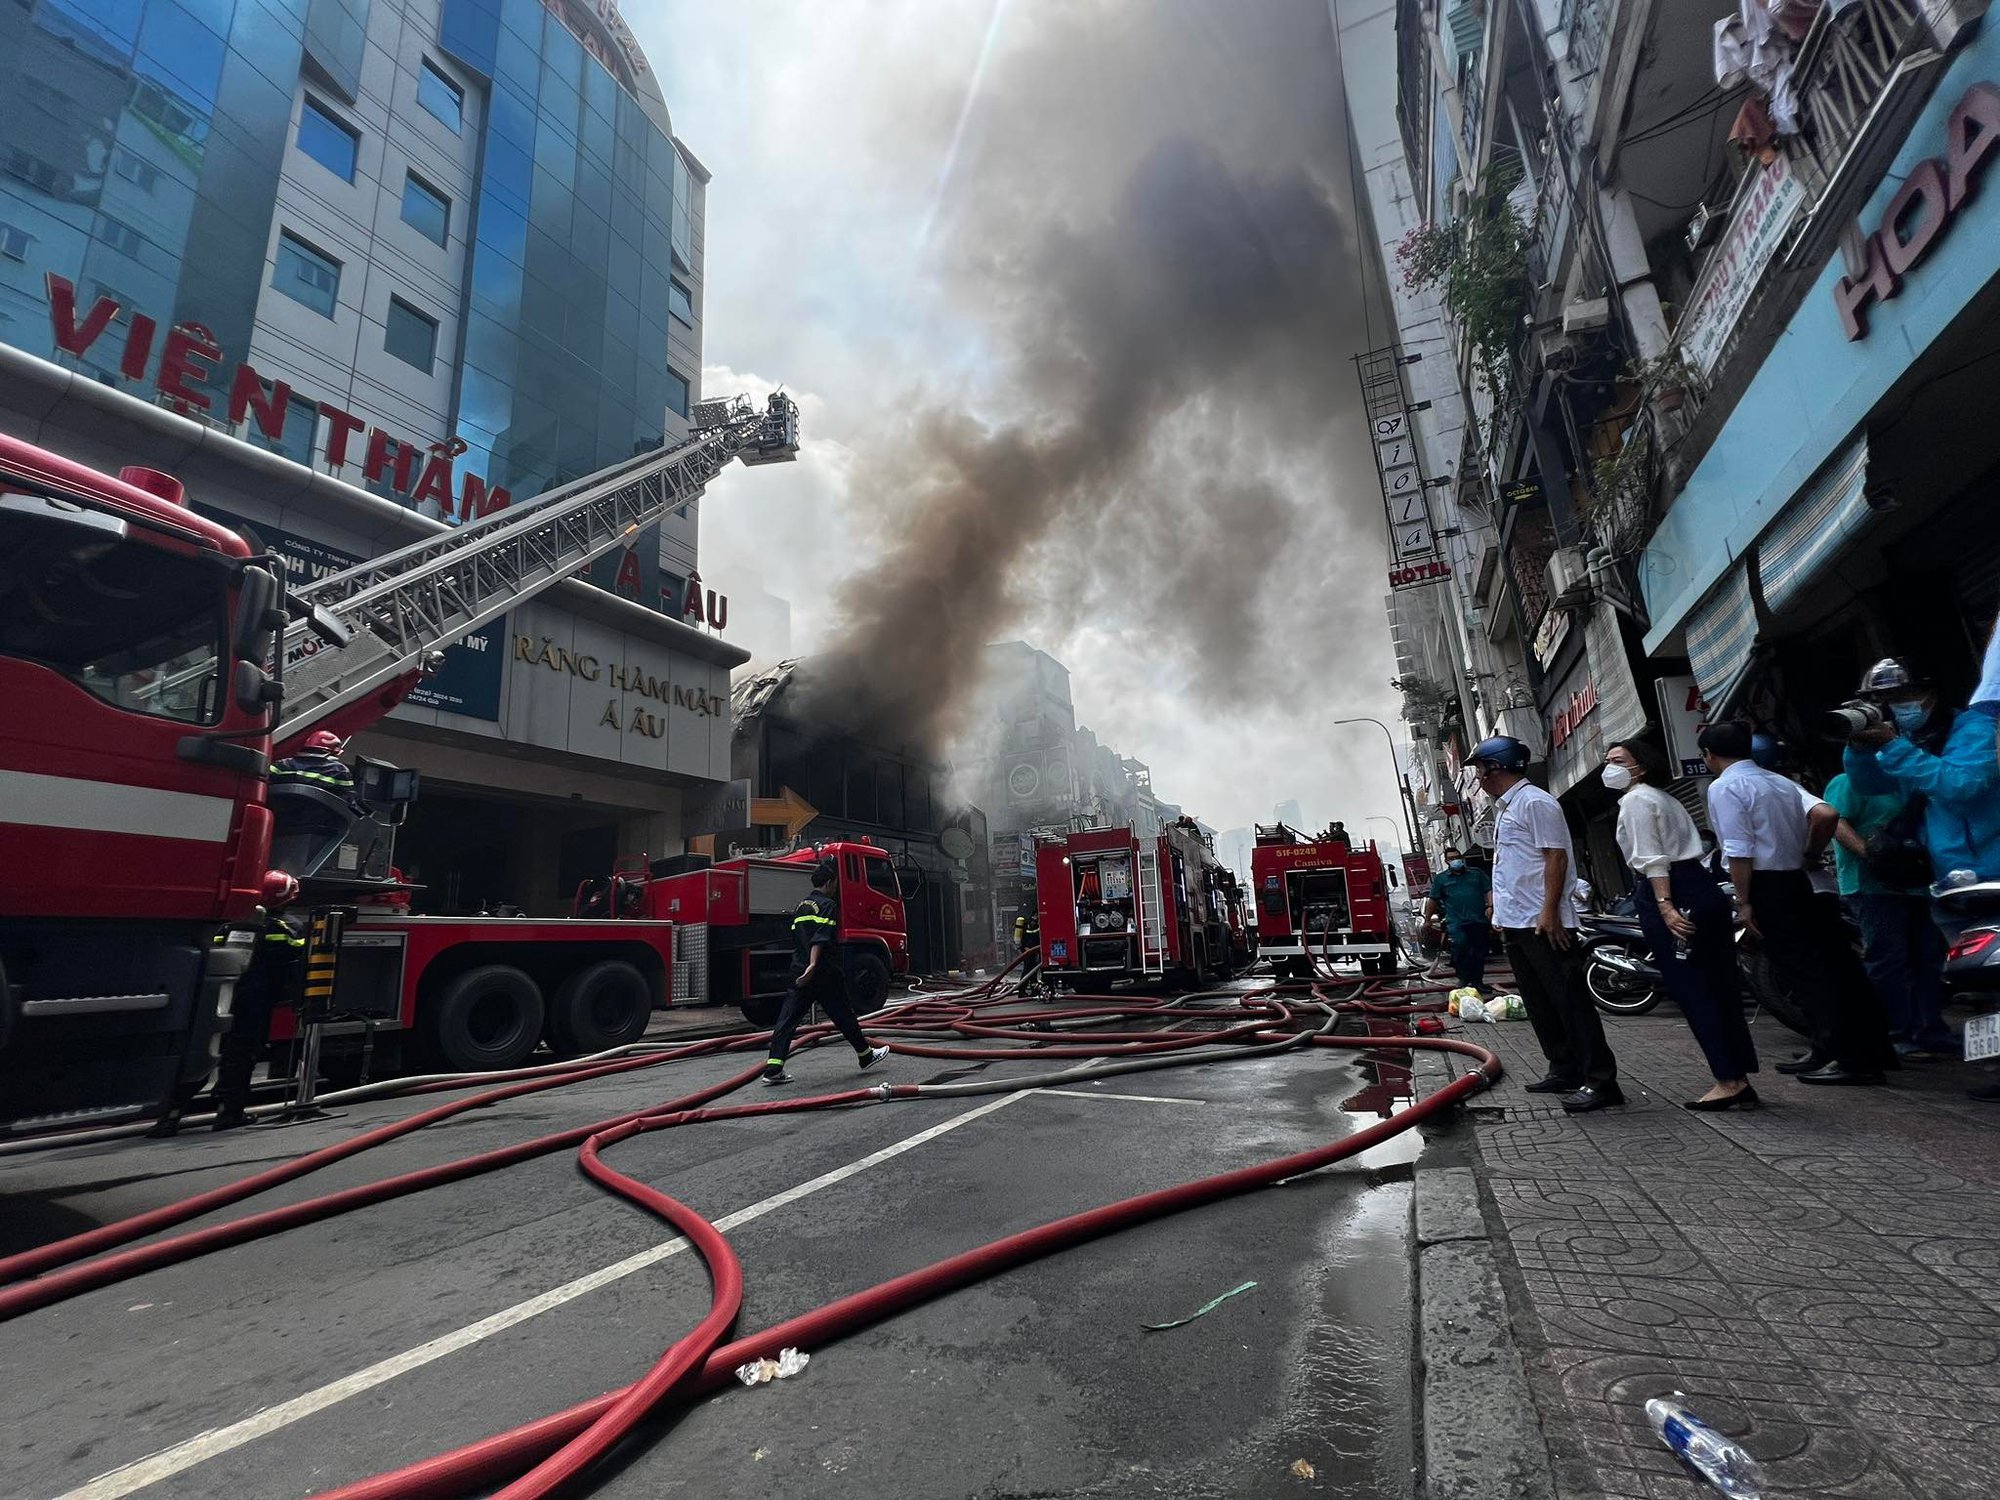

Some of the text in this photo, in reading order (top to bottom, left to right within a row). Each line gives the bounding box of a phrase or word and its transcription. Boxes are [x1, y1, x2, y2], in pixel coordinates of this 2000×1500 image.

[44, 271, 292, 440] VIỆN
[1389, 561, 1451, 587] HOTEL
[682, 570, 728, 630] ÂU
[514, 634, 726, 717] RĂNG HÀM MẶT
[630, 705, 666, 739] ÂU
[1686, 763, 1708, 775] 31B
[1275, 847, 1317, 857] 51F-0249
